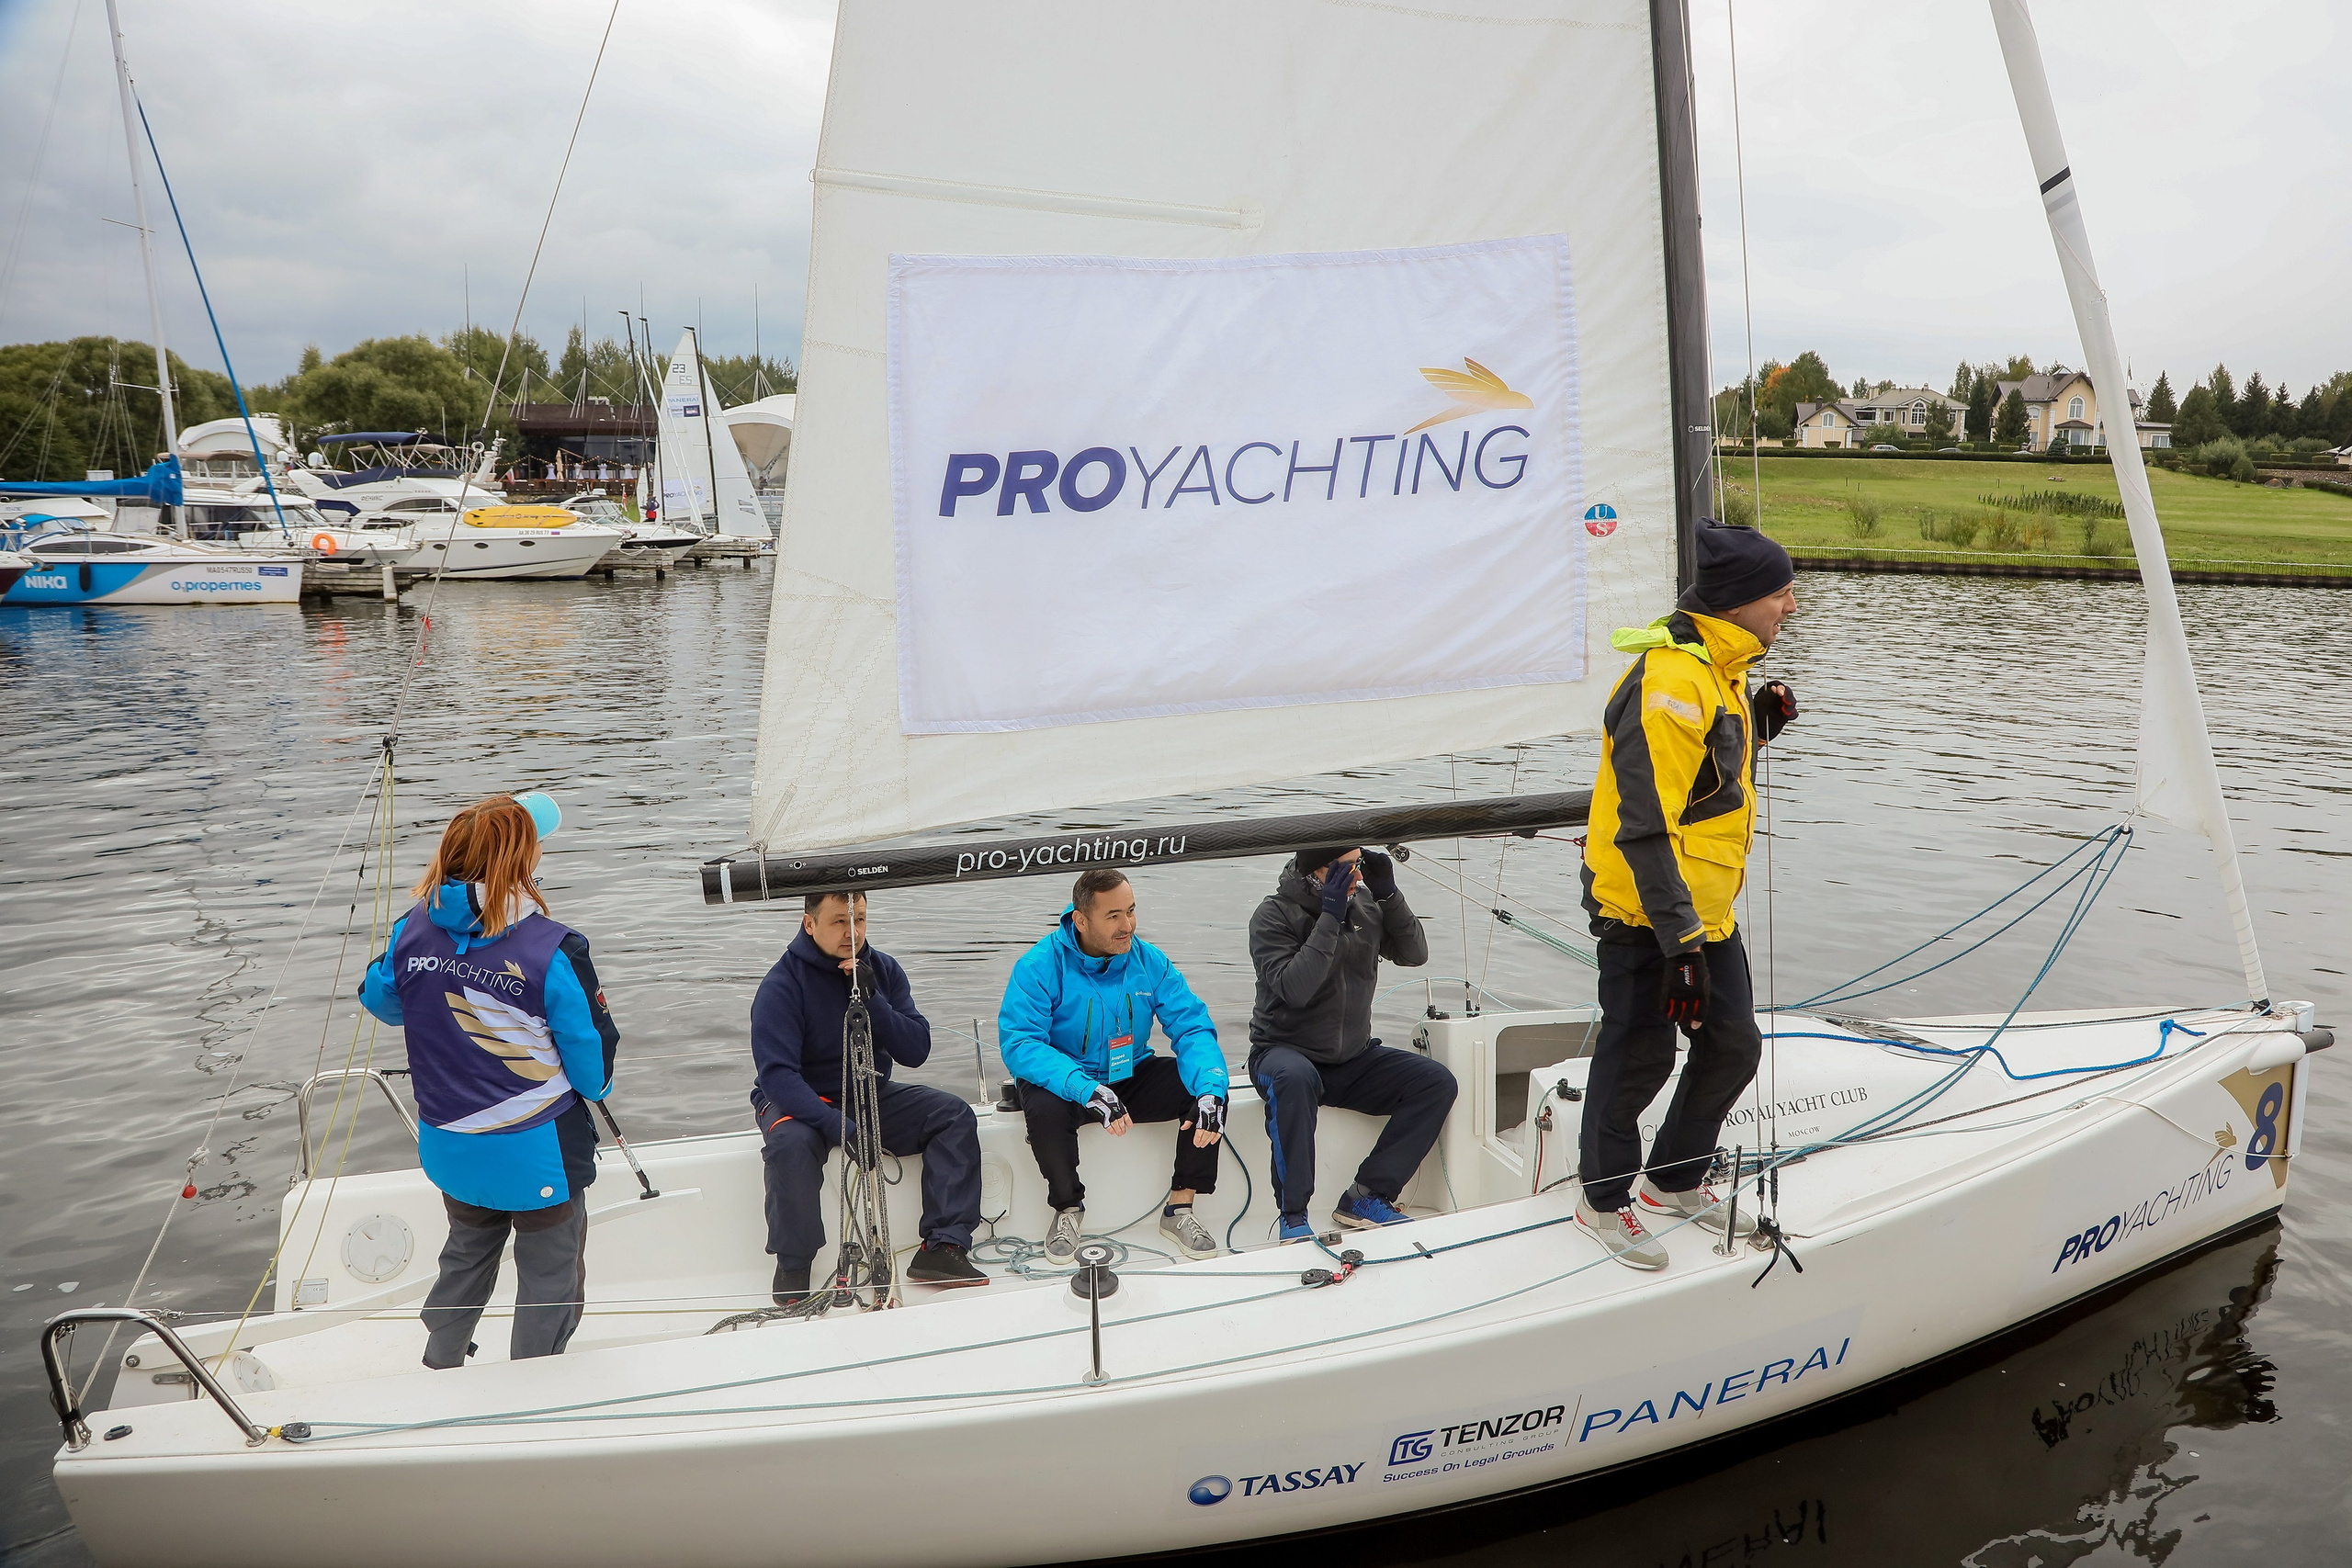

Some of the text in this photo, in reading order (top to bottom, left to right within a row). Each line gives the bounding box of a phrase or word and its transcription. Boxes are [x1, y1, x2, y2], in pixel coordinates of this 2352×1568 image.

[672, 363, 685, 373] 23
[938, 423, 1532, 518] PROYACHTING
[761, 542, 774, 550] 23
[857, 863, 888, 875] SELDÉN
[956, 835, 1186, 878] pro-yachting.ru
[1724, 1086, 1868, 1128] ROYAL YACHT CLUB
[2245, 1080, 2284, 1171] 8
[1788, 1125, 1821, 1138] MOSCOW
[2051, 1154, 2234, 1274] PROYACHTING
[1578, 1337, 1850, 1443] PANERAI
[1440, 1404, 1566, 1448] TENZOR
[1441, 1428, 1560, 1458] CONSULTING GROUP
[1238, 1461, 1367, 1497] TASSAY
[1383, 1441, 1555, 1483] Success On Legal Grounds
